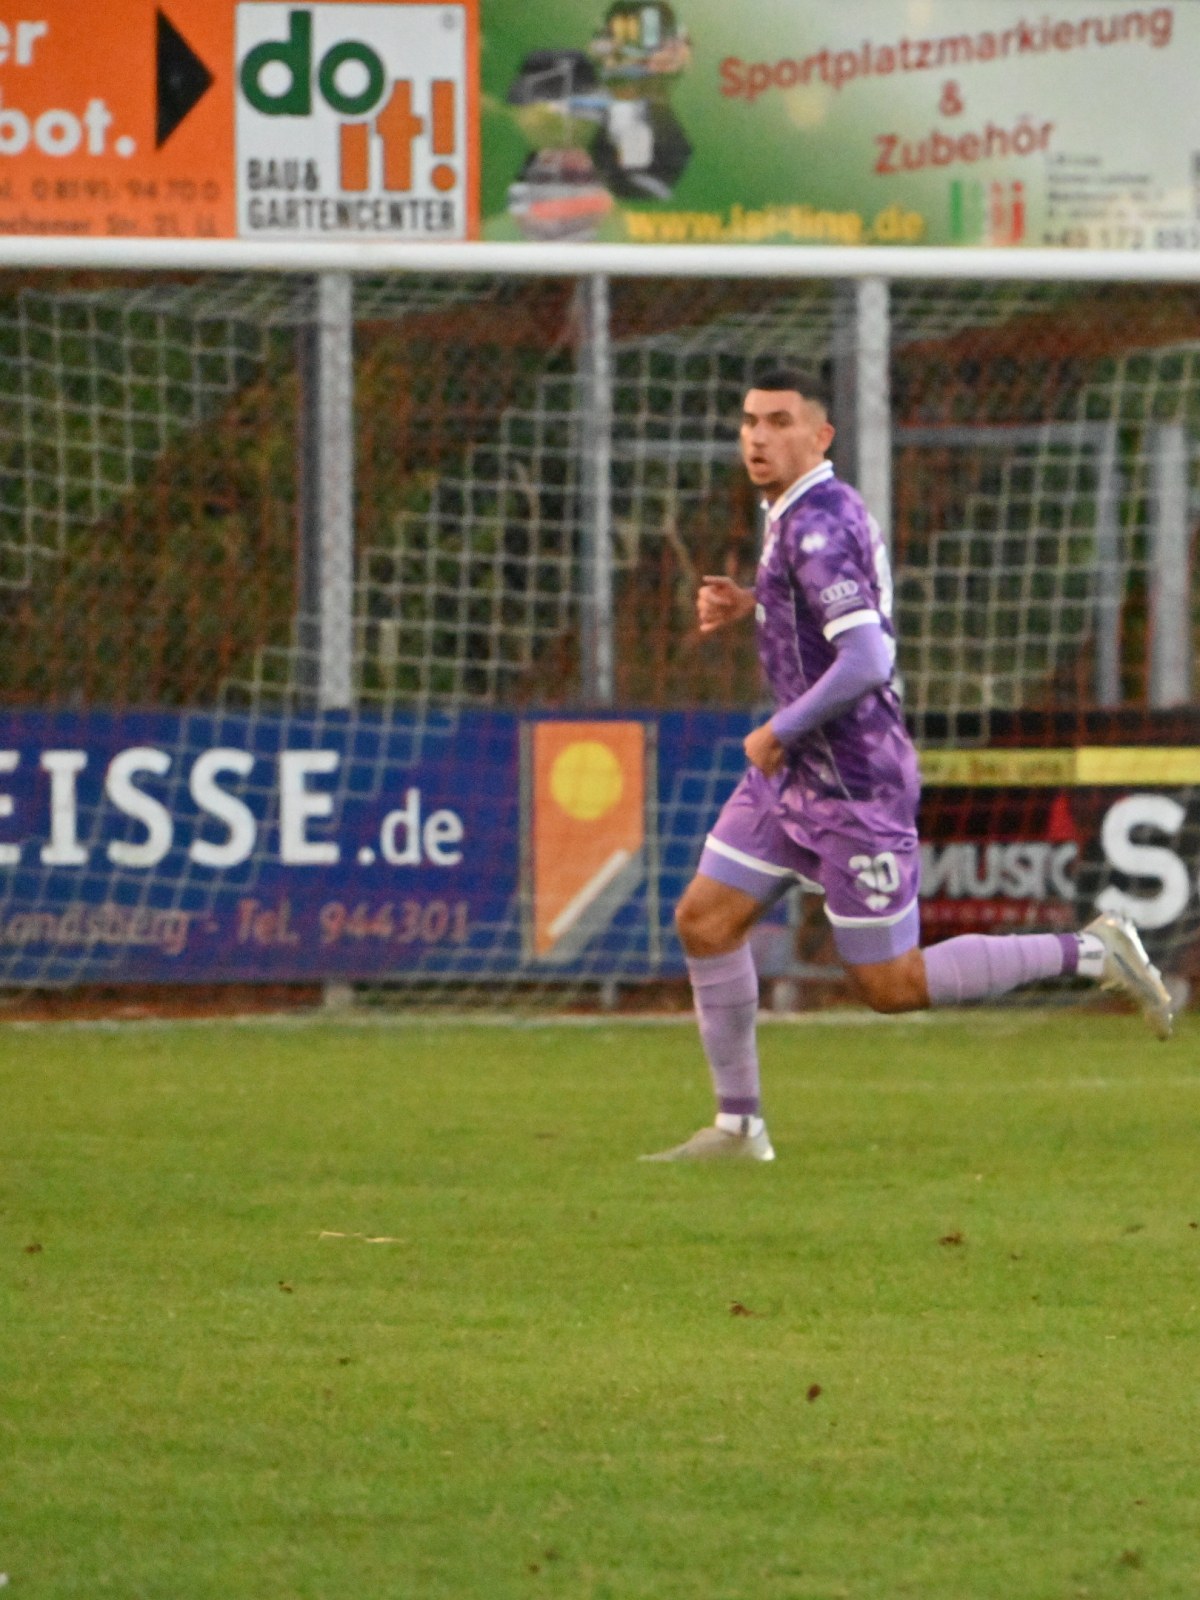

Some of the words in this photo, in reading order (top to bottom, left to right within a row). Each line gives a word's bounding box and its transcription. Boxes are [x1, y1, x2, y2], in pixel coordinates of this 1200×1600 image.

[0, 20, 48, 66] r
[240, 9, 385, 117] do
[718, 7, 1175, 103] Sportplatzmarkierung
[938, 79, 964, 118] &
[339, 79, 457, 192] it!
[873, 111, 1055, 176] Zubehör
[247, 158, 319, 192] BAU&
[248, 199, 456, 232] GARTENCENTER
